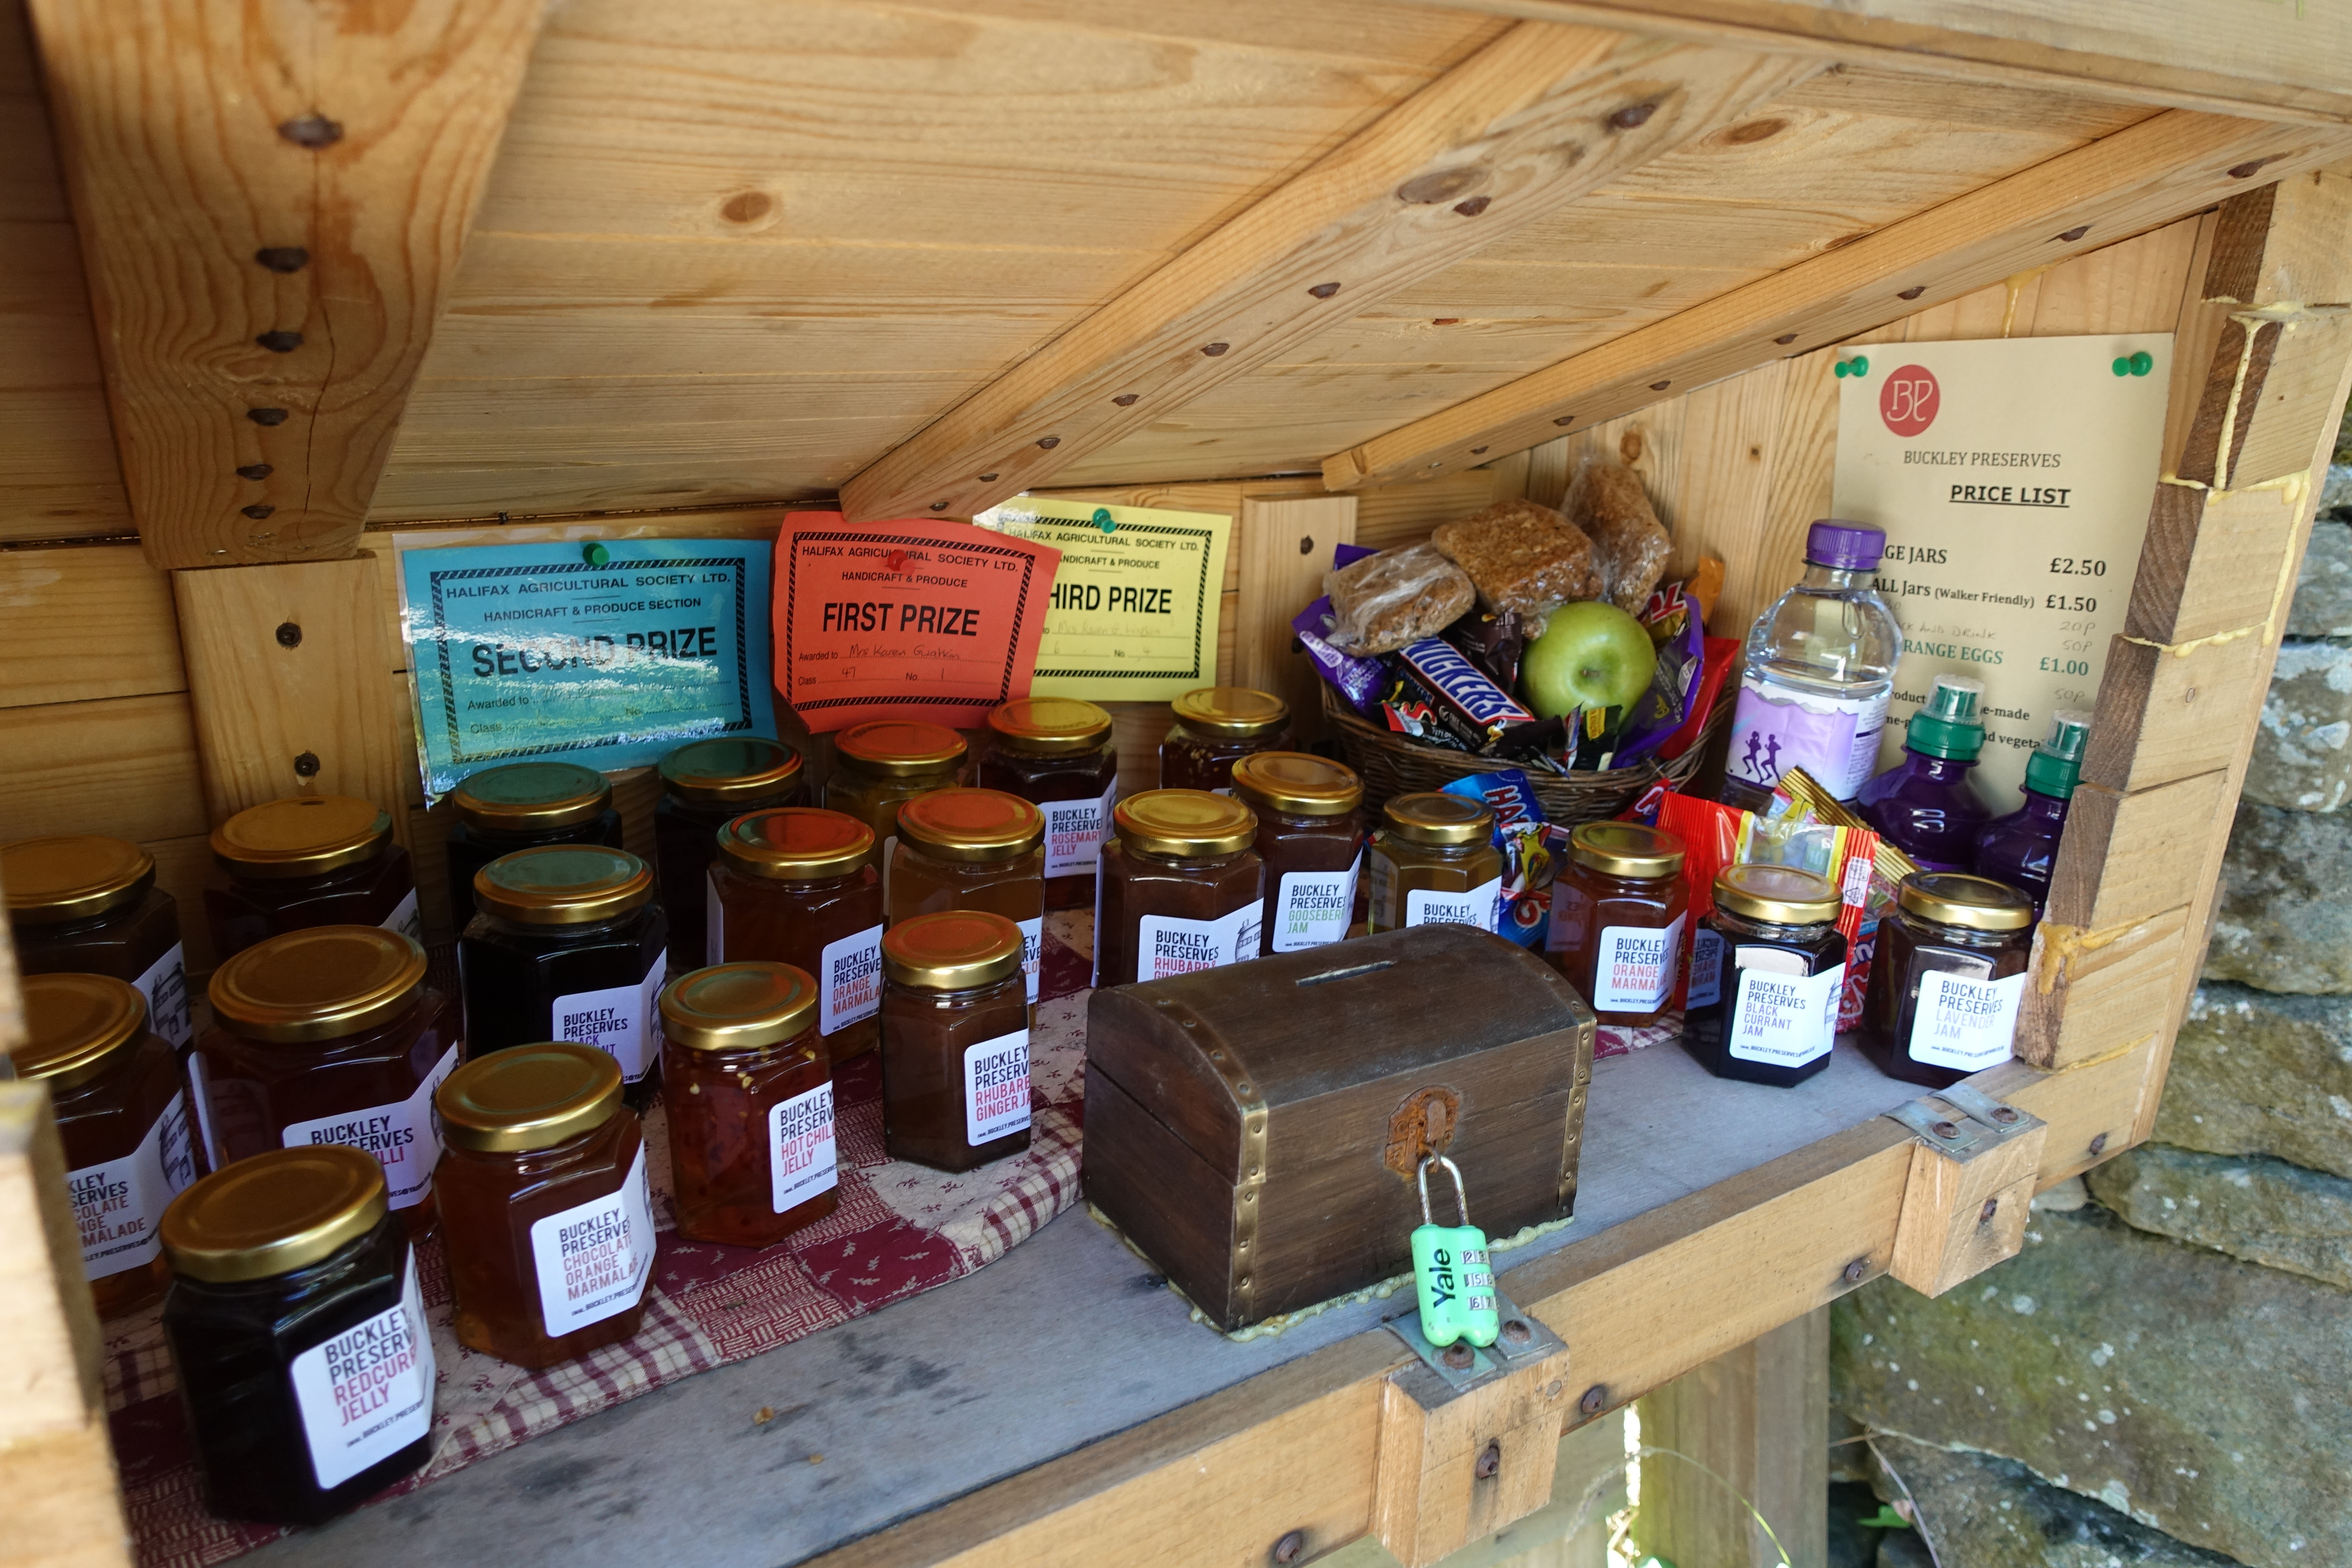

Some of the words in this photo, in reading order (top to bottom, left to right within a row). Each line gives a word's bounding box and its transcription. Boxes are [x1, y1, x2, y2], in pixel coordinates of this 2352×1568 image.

[1903, 450, 1968, 466] BUCKLEY
[1971, 452, 2062, 469] PRESERVES
[1950, 485, 2012, 502] PRICE
[2021, 487, 2072, 505] LIST
[1010, 528, 1052, 541] HALIFAX
[1055, 533, 1131, 547] AGRICULTURAL
[1135, 538, 1177, 550] SOCIETY
[1179, 542, 1200, 551] LTD.
[802, 545, 844, 557] HALIFAX
[938, 553, 989, 568] SOCIETY
[994, 560, 1018, 573] LTD.
[1118, 559, 1161, 570] PRODUCE
[1908, 547, 1948, 565] JARS
[2049, 557, 2107, 577] £2.50
[447, 582, 511, 599] HALIFAX
[518, 577, 629, 595] AGRICULTURAL
[636, 573, 696, 588] SOCIETY
[702, 572, 731, 584] LTD.
[842, 571, 903, 583] HANDICRAFT
[906, 575, 913, 583] &
[916, 575, 968, 588] PRODUCE
[1047, 583, 1101, 612] HIRD
[1107, 586, 1173, 614] PRIZE
[1902, 581, 1932, 597] Jars
[1934, 588, 1979, 603] (Walker
[1981, 591, 2035, 609] Friendly)
[2045, 594, 2098, 613] £1.50
[484, 606, 569, 622] HANDICRAFT
[572, 606, 581, 616] &
[584, 600, 646, 615] PRODUCE
[648, 597, 702, 610] SECTION
[822, 602, 894, 632] FIRST
[900, 604, 980, 637] PRIZE
[472, 634, 616, 677] SECOND
[626, 626, 717, 665] PRIZE
[798, 650, 830, 662] Awarded
[830, 650, 839, 659] to
[849, 644, 869, 658] Mrs
[872, 646, 907, 657] Karen
[1903, 638, 1957, 658] RANGE
[1960, 646, 2004, 665] EGGS
[2039, 656, 2089, 676] £1.00
[798, 676, 817, 686] Class
[842, 666, 856, 680] 47
[905, 672, 919, 682] No.
[1401, 635, 1529, 722] NICKERS
[467, 696, 516, 710] Awarded
[518, 695, 530, 706] to
[1981, 705, 2030, 721] e-made
[470, 722, 502, 735] Class
[1999, 735, 2041, 750] vegeta
[1052, 808, 1097, 821] BUCKLEY
[1051, 844, 1077, 857] JELLY
[1292, 884, 1340, 897] BUCKLEY
[1424, 903, 1471, 918] BUCKLEY
[1156, 929, 1210, 948] BUCKLEY
[1287, 922, 1308, 934] JAM
[1155, 943, 1219, 961] PRESERVES
[1616, 937, 1666, 952] BUCKLEY
[834, 945, 877, 974] BUCKLEY
[833, 957, 881, 988] PRESERVE
[1613, 964, 1660, 978] ORANGE
[833, 975, 871, 1002] ORANGE
[1749, 980, 1796, 996] BUCKLEY
[1941, 980, 1998, 1001] BUCKLEY
[833, 985, 880, 1017] MARMALA
[1746, 1002, 1779, 1017] BLACK
[1747, 991, 1807, 1009] PRESERVES
[1939, 995, 2003, 1015] PRESERVES
[564, 1008, 615, 1027] BUCKLEY
[1744, 1013, 1792, 1030] CURRANT
[1936, 1008, 1995, 1029] LAVENDER
[564, 1018, 628, 1039] PRESERVES
[1742, 1024, 1764, 1037] JAM
[1933, 1023, 1961, 1040] JAM
[974, 1043, 1029, 1075] BUCKLEY
[975, 1060, 1029, 1091] PRESERV
[975, 1075, 1031, 1107] RHUBARB
[780, 1088, 833, 1127] BUCKLEY
[976, 1095, 1019, 1123] GINGER
[311, 1115, 391, 1145] BUCKLEY
[781, 1105, 834, 1144] PRESERV
[781, 1136, 804, 1161] HOT
[782, 1148, 815, 1177] JELLY
[81, 1217, 147, 1248] MALADE
[559, 1207, 620, 1243] BUCKLEY
[566, 1253, 620, 1286] ORANGE
[1428, 1248, 1456, 1309] Yale
[342, 1382, 390, 1427] JELLY
